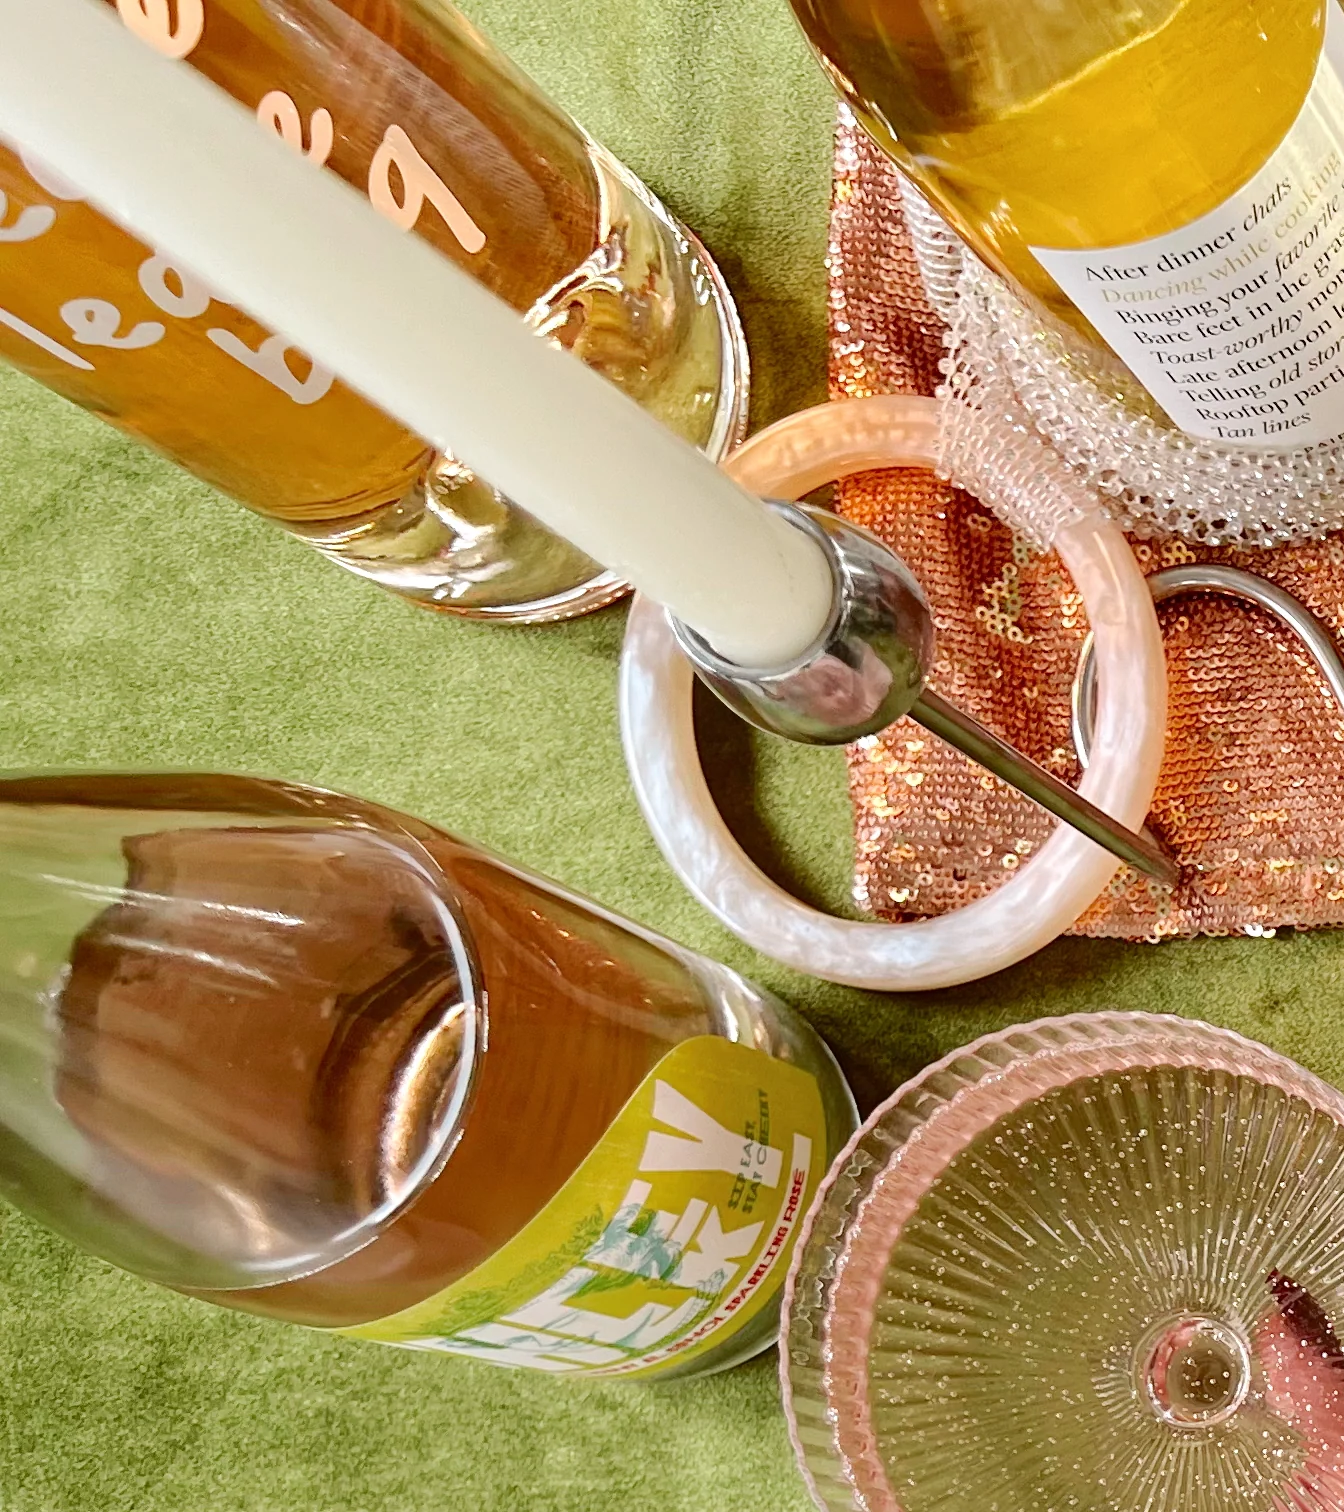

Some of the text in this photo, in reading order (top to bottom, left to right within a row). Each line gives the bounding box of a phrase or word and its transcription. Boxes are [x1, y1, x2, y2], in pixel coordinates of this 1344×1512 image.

[1085, 176, 1293, 283] After dinner chats
[1101, 152, 1341, 304] Dancing while cooking
[1114, 297, 1220, 327] Binging
[1218, 267, 1270, 312] your
[1273, 194, 1341, 283] favorite
[1133, 329, 1193, 345] Bare
[1196, 315, 1244, 340] feet
[1249, 300, 1273, 320] in
[1276, 272, 1312, 305] the
[1149, 309, 1304, 366] Toast-worthy
[1165, 369, 1221, 387] Late
[1225, 319, 1333, 379] afternoon
[1179, 381, 1268, 403] Telling
[1269, 362, 1302, 390] old
[1196, 395, 1290, 422] Rooftop
[1211, 411, 1312, 440] Tan lines
[727, 1171, 748, 1211] SIP
[724, 1226, 790, 1313] SPARKLING
